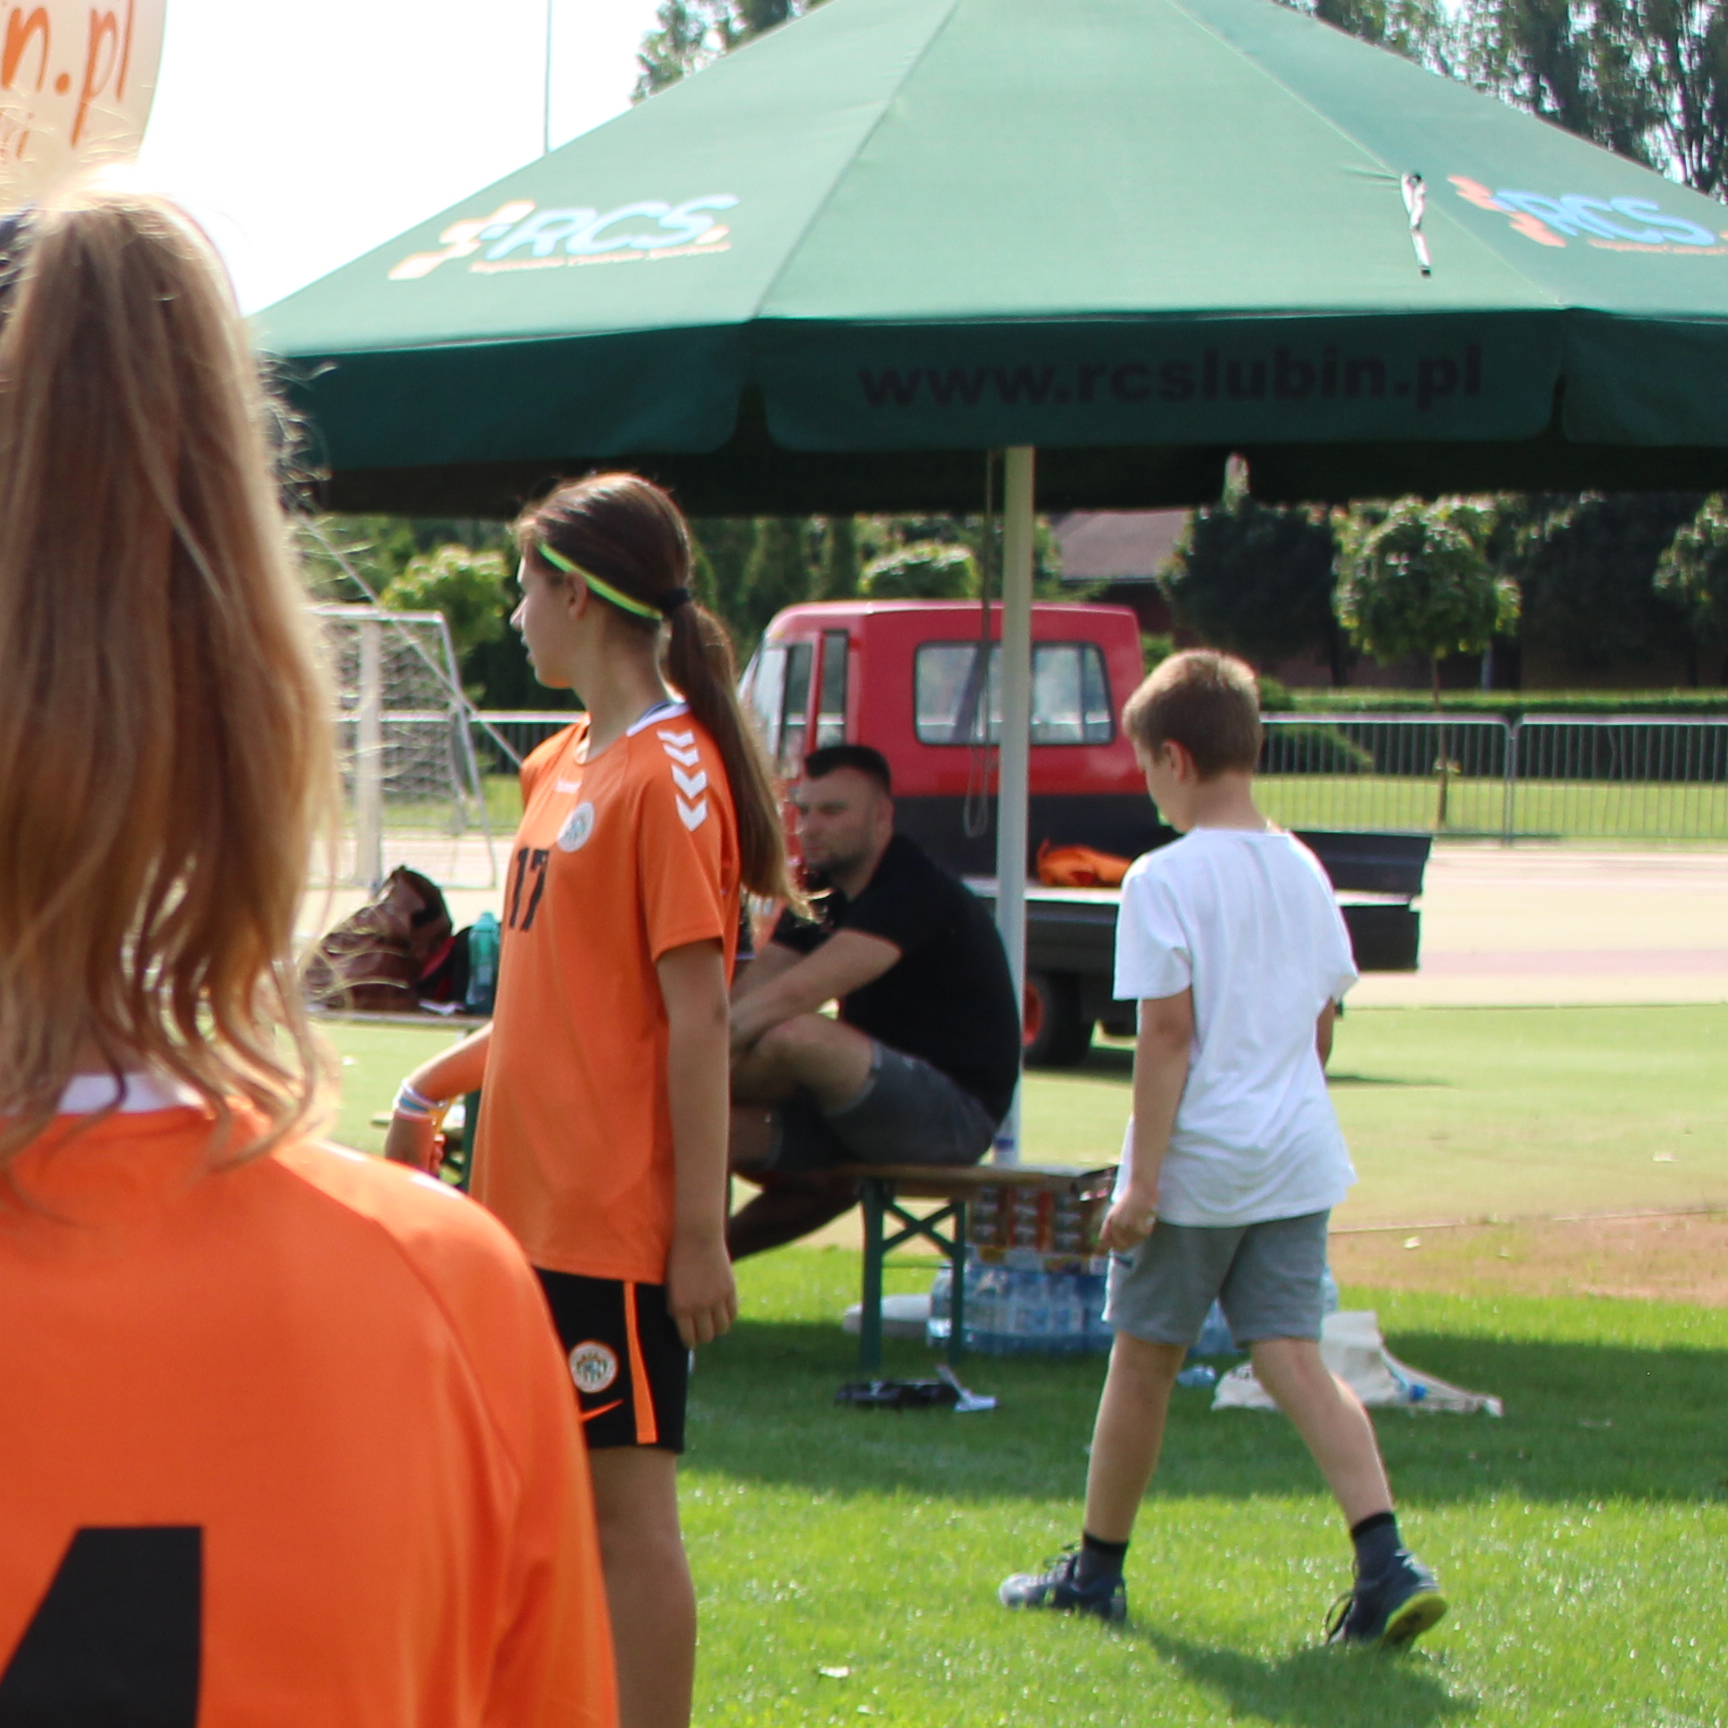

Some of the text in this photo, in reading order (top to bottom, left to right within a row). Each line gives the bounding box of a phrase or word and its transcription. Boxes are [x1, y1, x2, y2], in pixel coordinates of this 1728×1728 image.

[485, 193, 739, 261] RCS
[1495, 187, 1716, 246] RCS
[857, 345, 1483, 410] www.rcslubin.pl
[508, 846, 550, 932] 17
